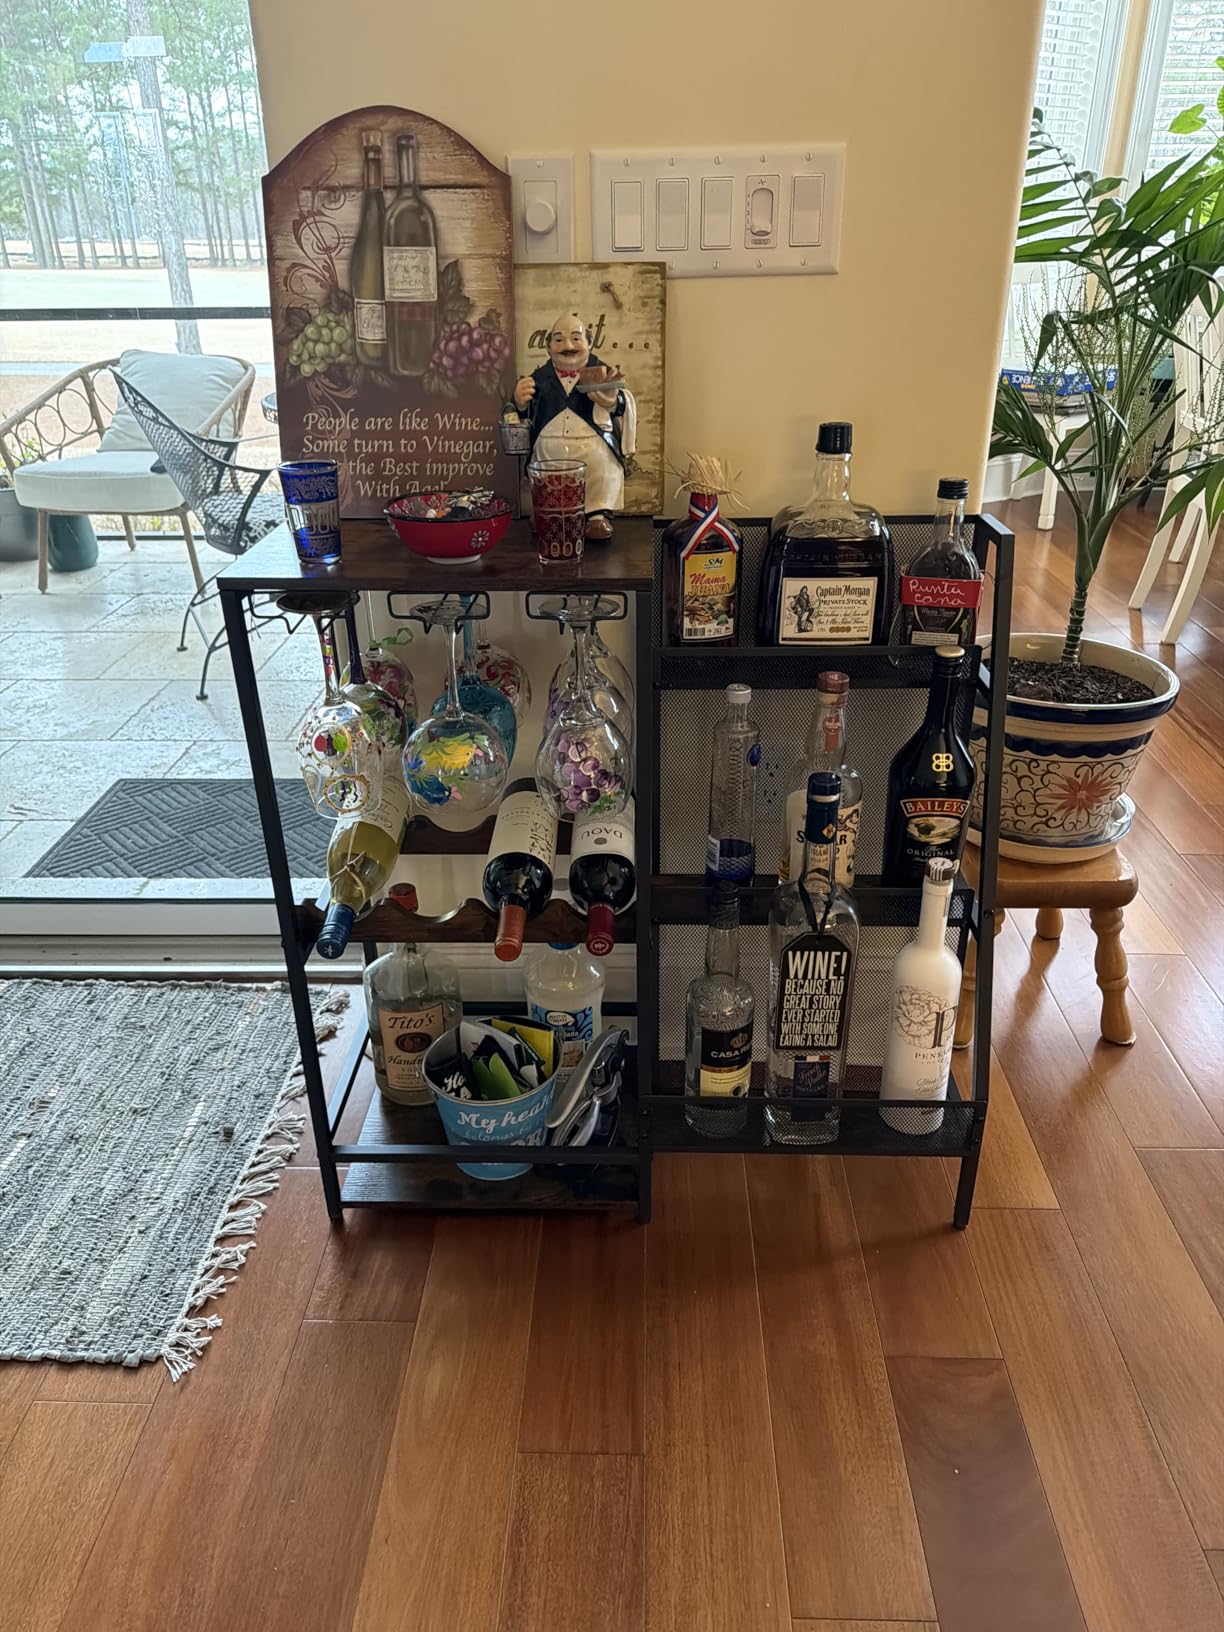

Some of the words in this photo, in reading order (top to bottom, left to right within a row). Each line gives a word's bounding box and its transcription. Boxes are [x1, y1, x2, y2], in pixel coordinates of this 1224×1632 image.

[303, 408, 359, 439] People
[365, 417, 393, 431] are
[400, 408, 429, 431] like
[434, 413, 494, 431] Wine...
[302, 435, 348, 453] Some
[354, 438, 394, 453] turn
[400, 437, 417, 453] to
[422, 435, 497, 462] Vinegar,
[349, 454, 374, 475] the
[381, 458, 419, 475] Best
[426, 459, 495, 482] improve
[356, 476, 400, 497] With
[816, 585, 842, 598] Captain
[842, 584, 871, 598] Morgan
[847, 598, 868, 606] STOCK
[905, 800, 967, 813] BAILEYS
[581, 826, 623, 840] DAOU
[906, 848, 955, 857] ORIGINAL
[788, 950, 848, 980] WINE!
[785, 979, 829, 995] BECAUSE
[830, 979, 845, 995] NO
[783, 995, 811, 1009] GREAT
[812, 995, 842, 1009] STORY
[387, 1013, 436, 1029] Tito's
[782, 1009, 803, 1023] EVER
[804, 1009, 840, 1023] STARTED
[781, 1022, 801, 1034] WITH
[802, 1022, 839, 1035] SOMEONE
[780, 1034, 806, 1047] EATING
[806, 1034, 813, 1047] A
[813, 1034, 838, 1047] SALAD
[710, 1049, 740, 1058] CASA
[457, 1111, 497, 1134] My
